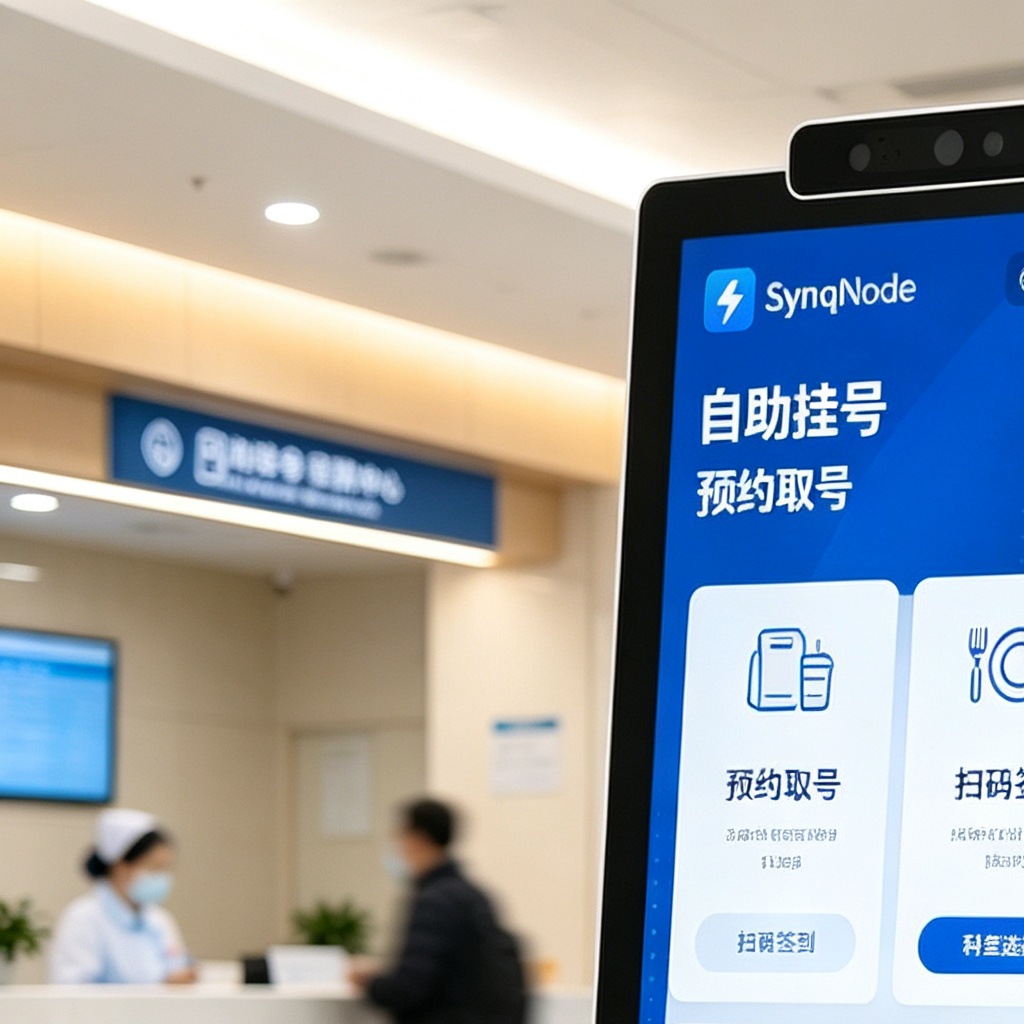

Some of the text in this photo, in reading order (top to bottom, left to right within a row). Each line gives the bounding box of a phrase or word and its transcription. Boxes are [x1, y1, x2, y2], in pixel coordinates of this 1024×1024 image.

[765, 273, 917, 318] SynqNode
[702, 380, 887, 445] 自助挂号
[696, 465, 853, 518] 预约取号
[725, 768, 841, 801] 预约取号
